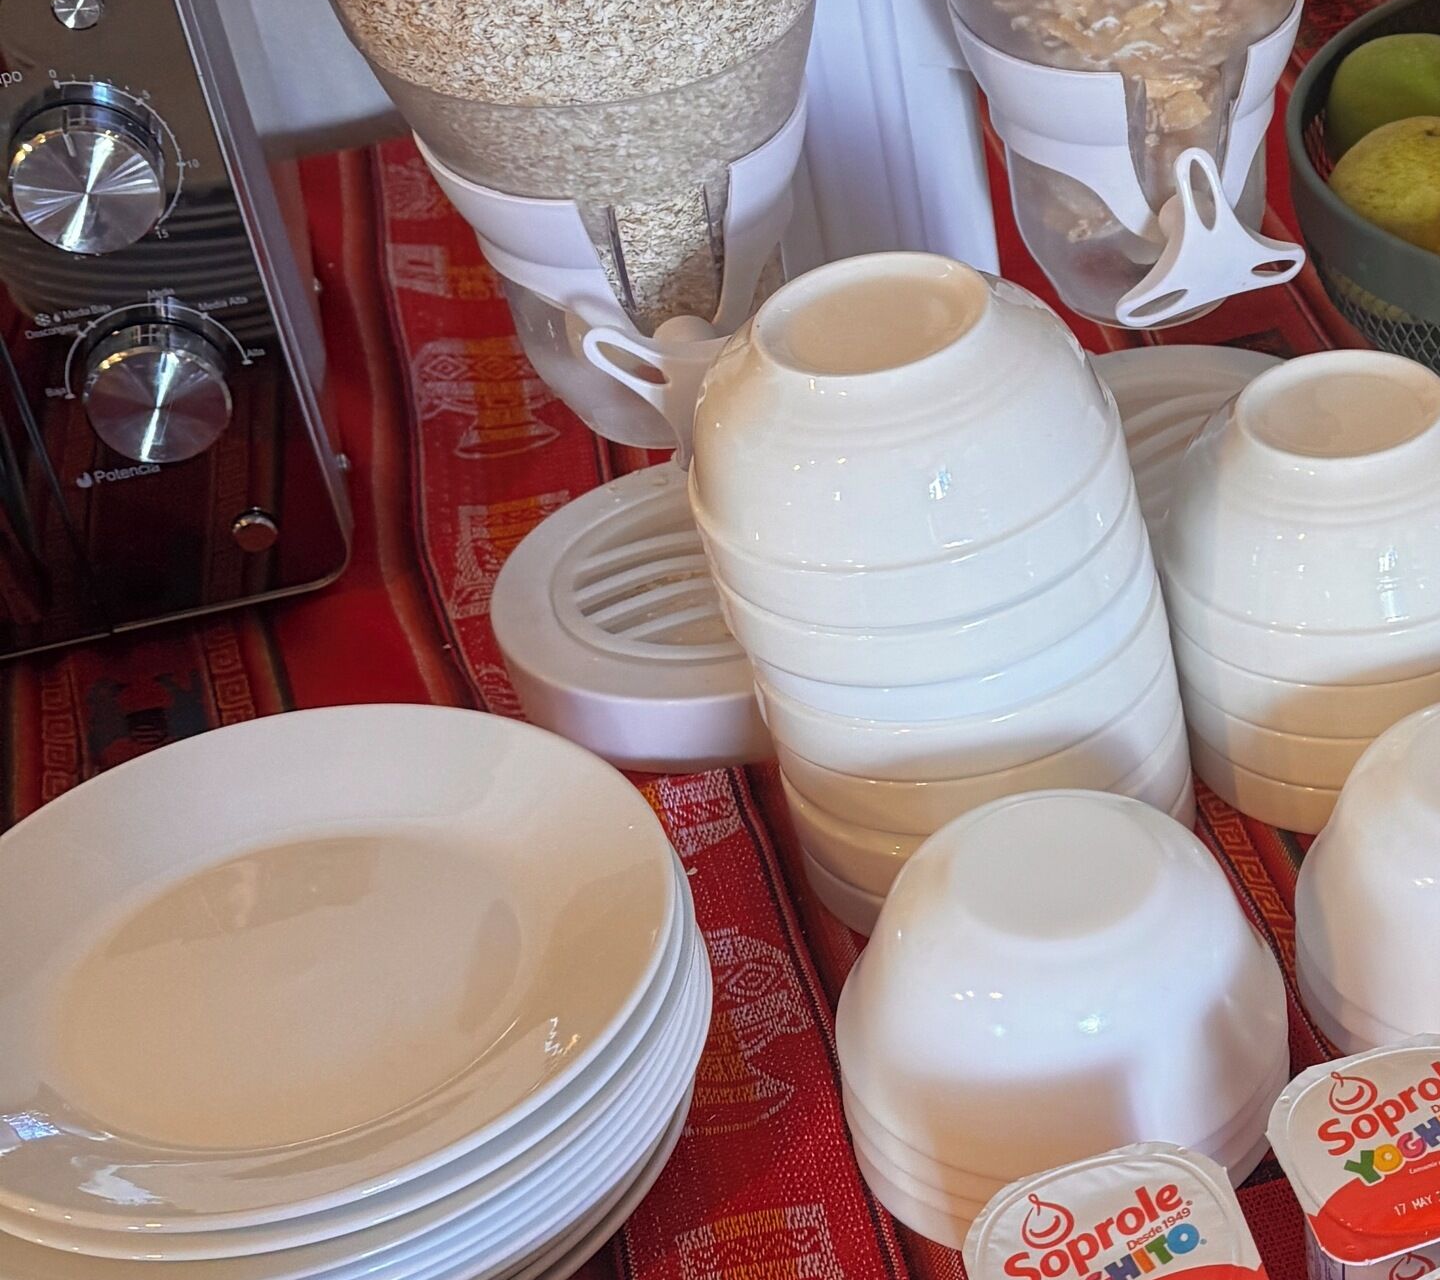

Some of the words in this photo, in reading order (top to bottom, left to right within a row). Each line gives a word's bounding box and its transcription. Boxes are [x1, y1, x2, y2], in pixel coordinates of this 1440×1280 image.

[48, 69, 57, 79] 0
[187, 159, 200, 169] 10
[155, 229, 169, 239] 15
[94, 464, 161, 483] Potencia
[1394, 1202, 1407, 1216] 17
[1411, 1195, 1433, 1210] MAY
[1126, 1225, 1162, 1251] Desde
[1162, 1207, 1191, 1229] 1949
